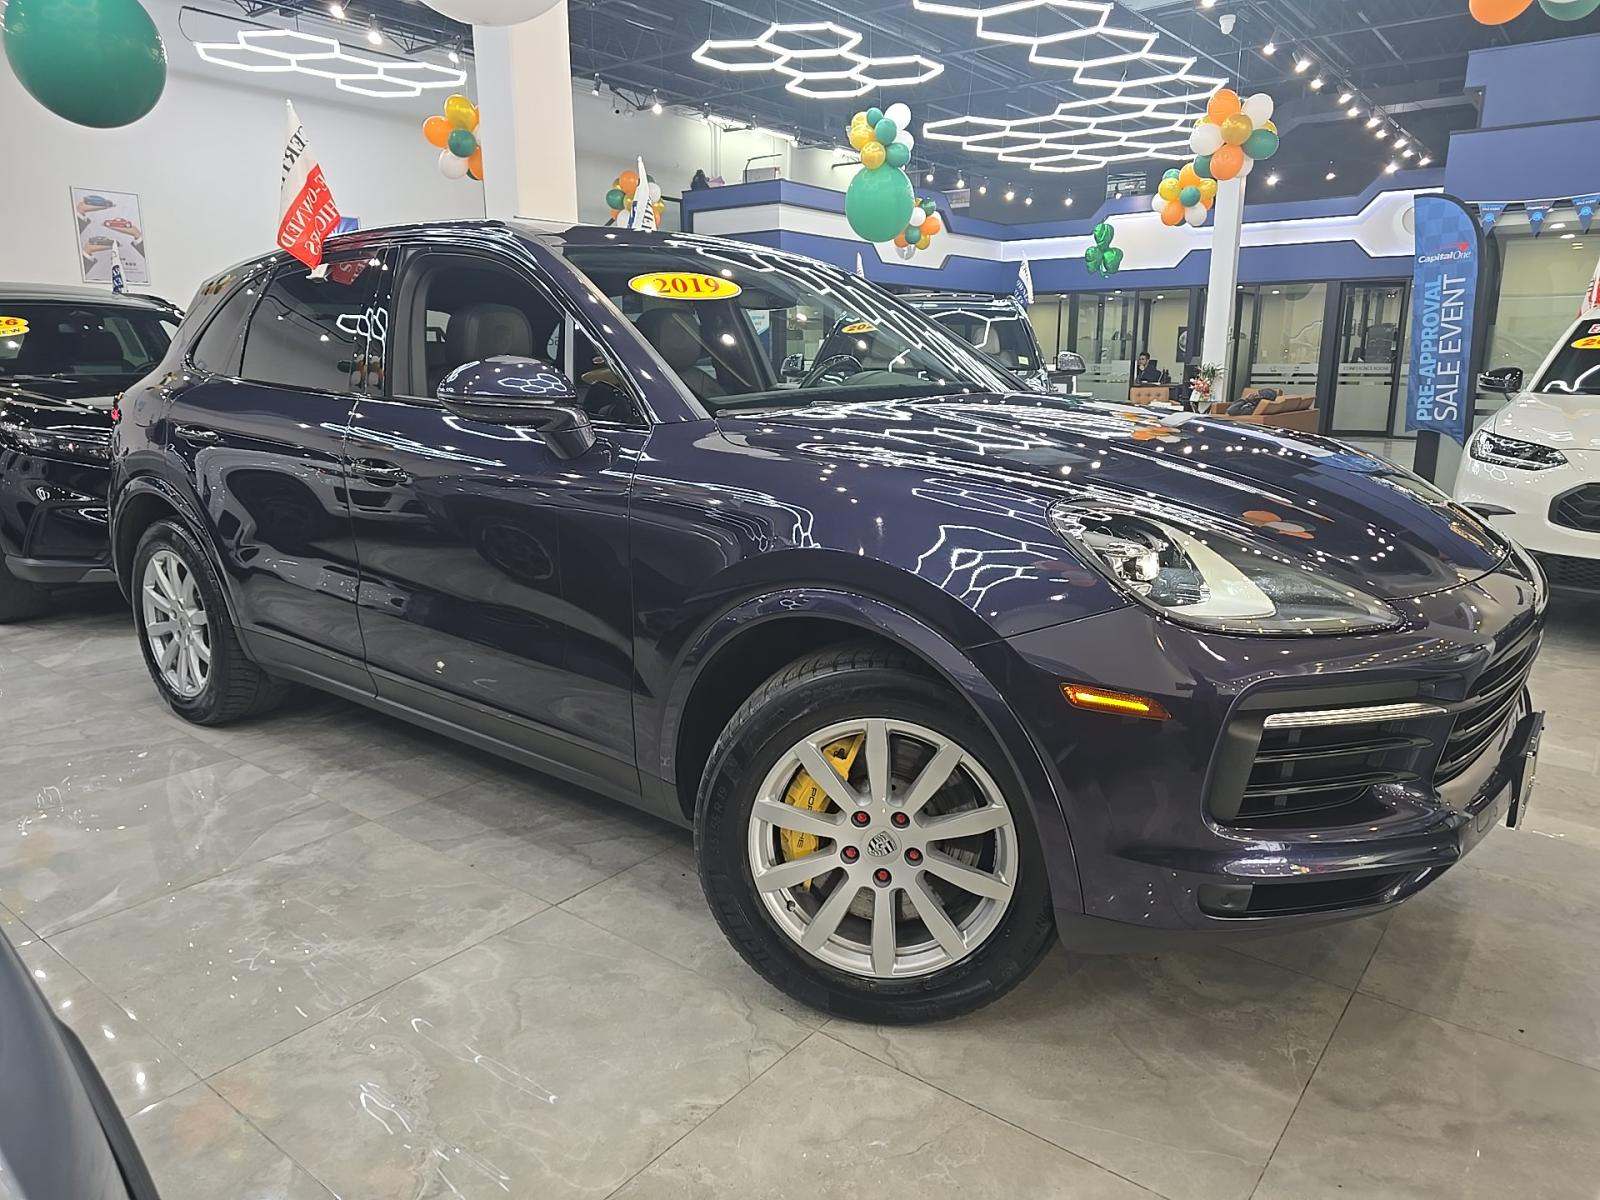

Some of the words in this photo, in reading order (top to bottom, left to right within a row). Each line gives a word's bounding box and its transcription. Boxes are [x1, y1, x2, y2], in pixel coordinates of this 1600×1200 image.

[653, 277, 720, 293] 2019
[1439, 274, 1466, 354] EVENT
[1416, 274, 1442, 421] PRE-APPROVAL
[1434, 360, 1460, 421] SALE
